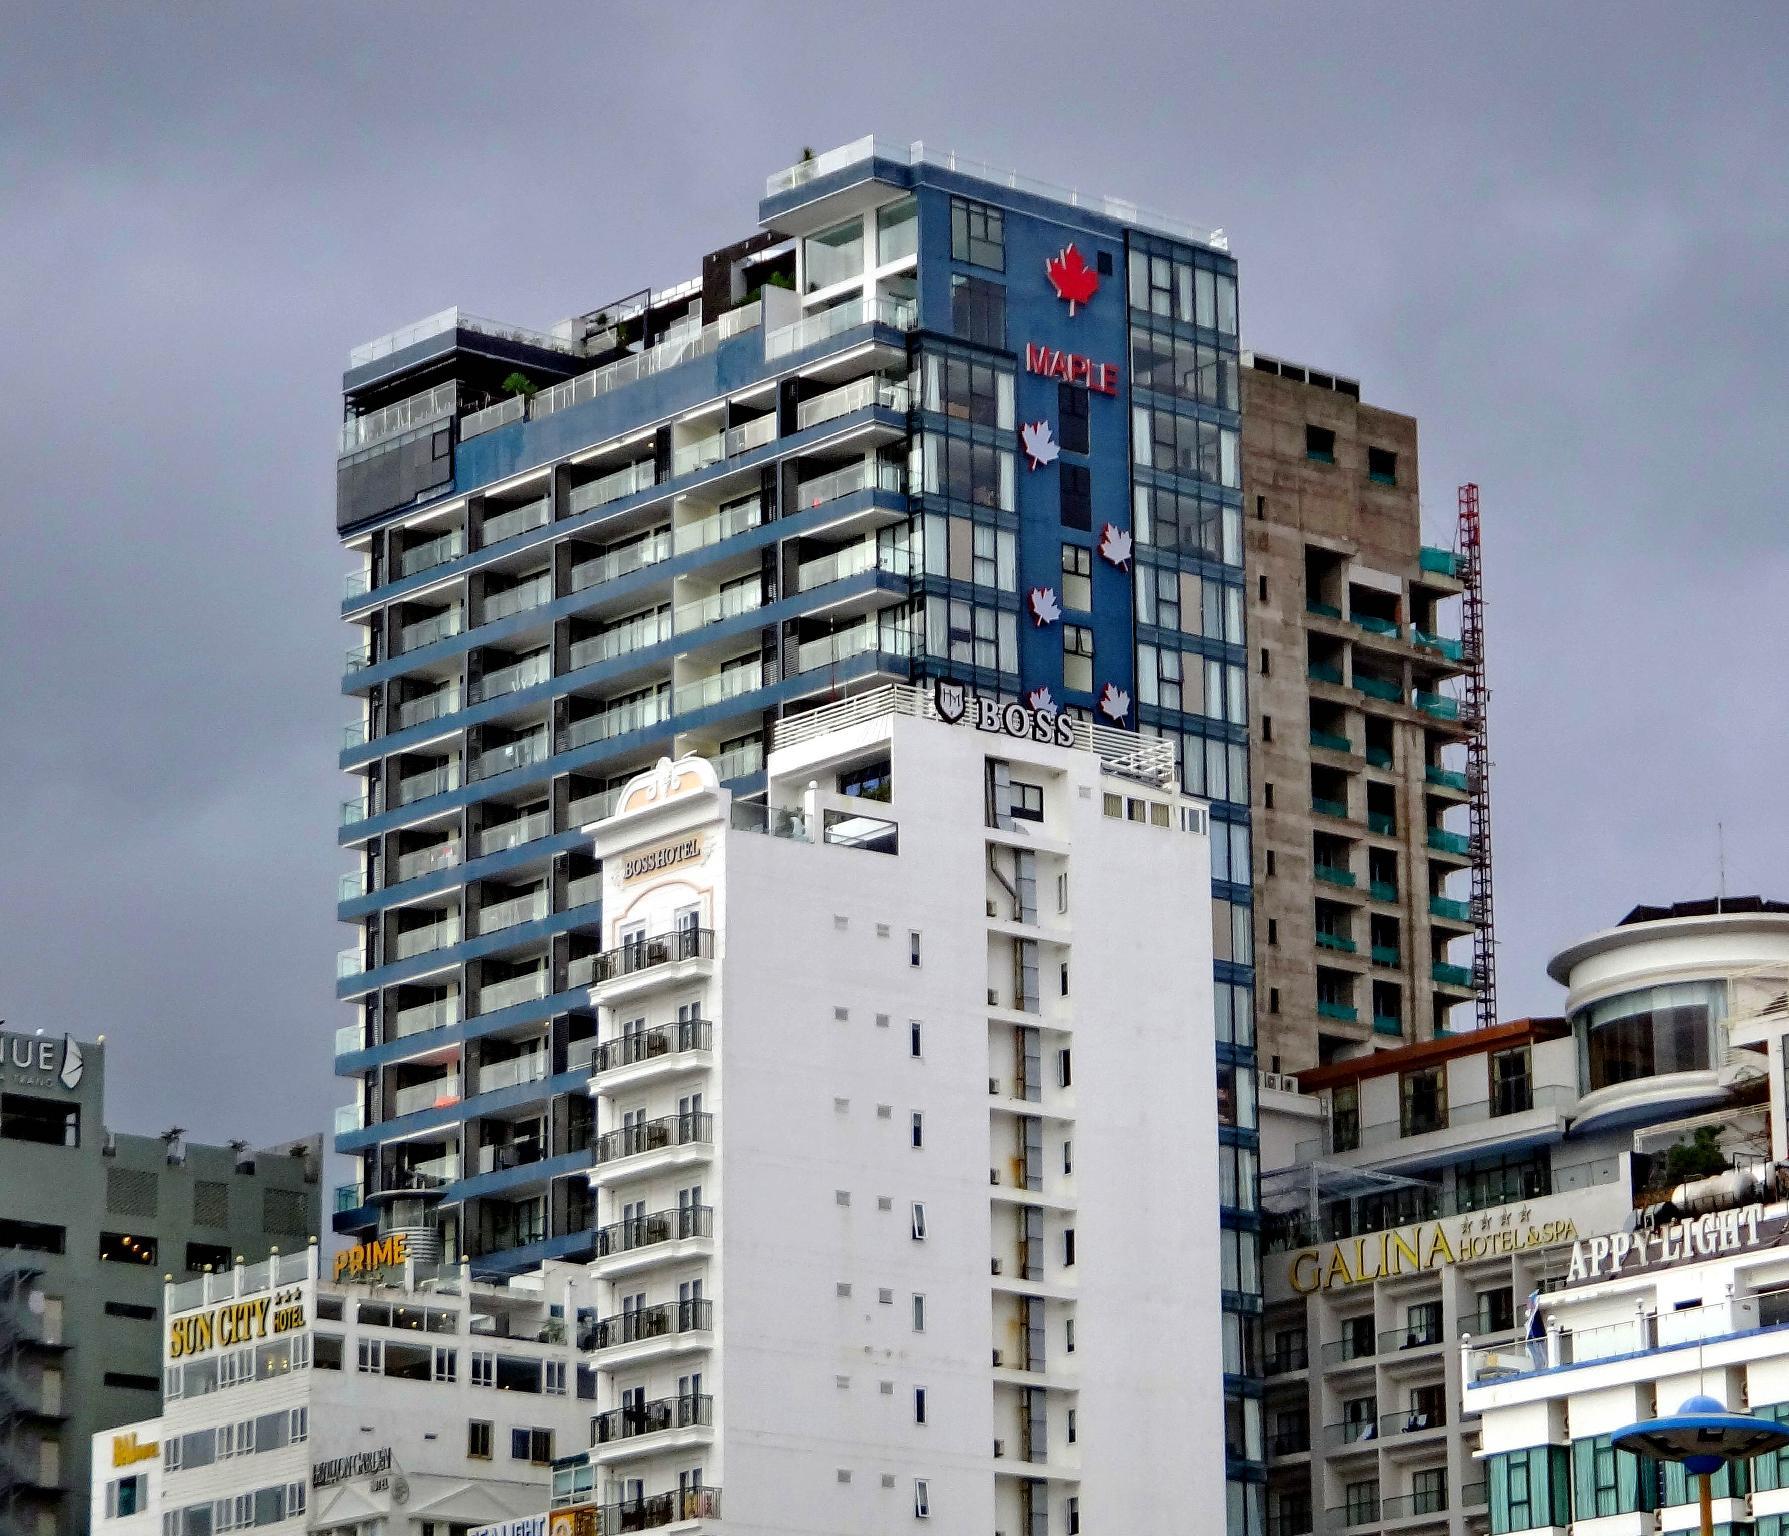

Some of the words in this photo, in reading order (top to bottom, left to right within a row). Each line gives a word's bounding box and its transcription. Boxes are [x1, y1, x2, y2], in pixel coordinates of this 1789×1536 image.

[1026, 342, 1119, 396] MAPLE
[976, 697, 1075, 747] BOSS
[333, 1233, 407, 1281] PRIME
[1289, 1222, 1455, 1294] GALINA
[1566, 1228, 1651, 1282] APPY
[1659, 1203, 1763, 1262] LIGHT
[171, 1310, 215, 1357] SUN
[216, 1297, 271, 1346] CITY
[273, 1304, 306, 1333] HOTEL
